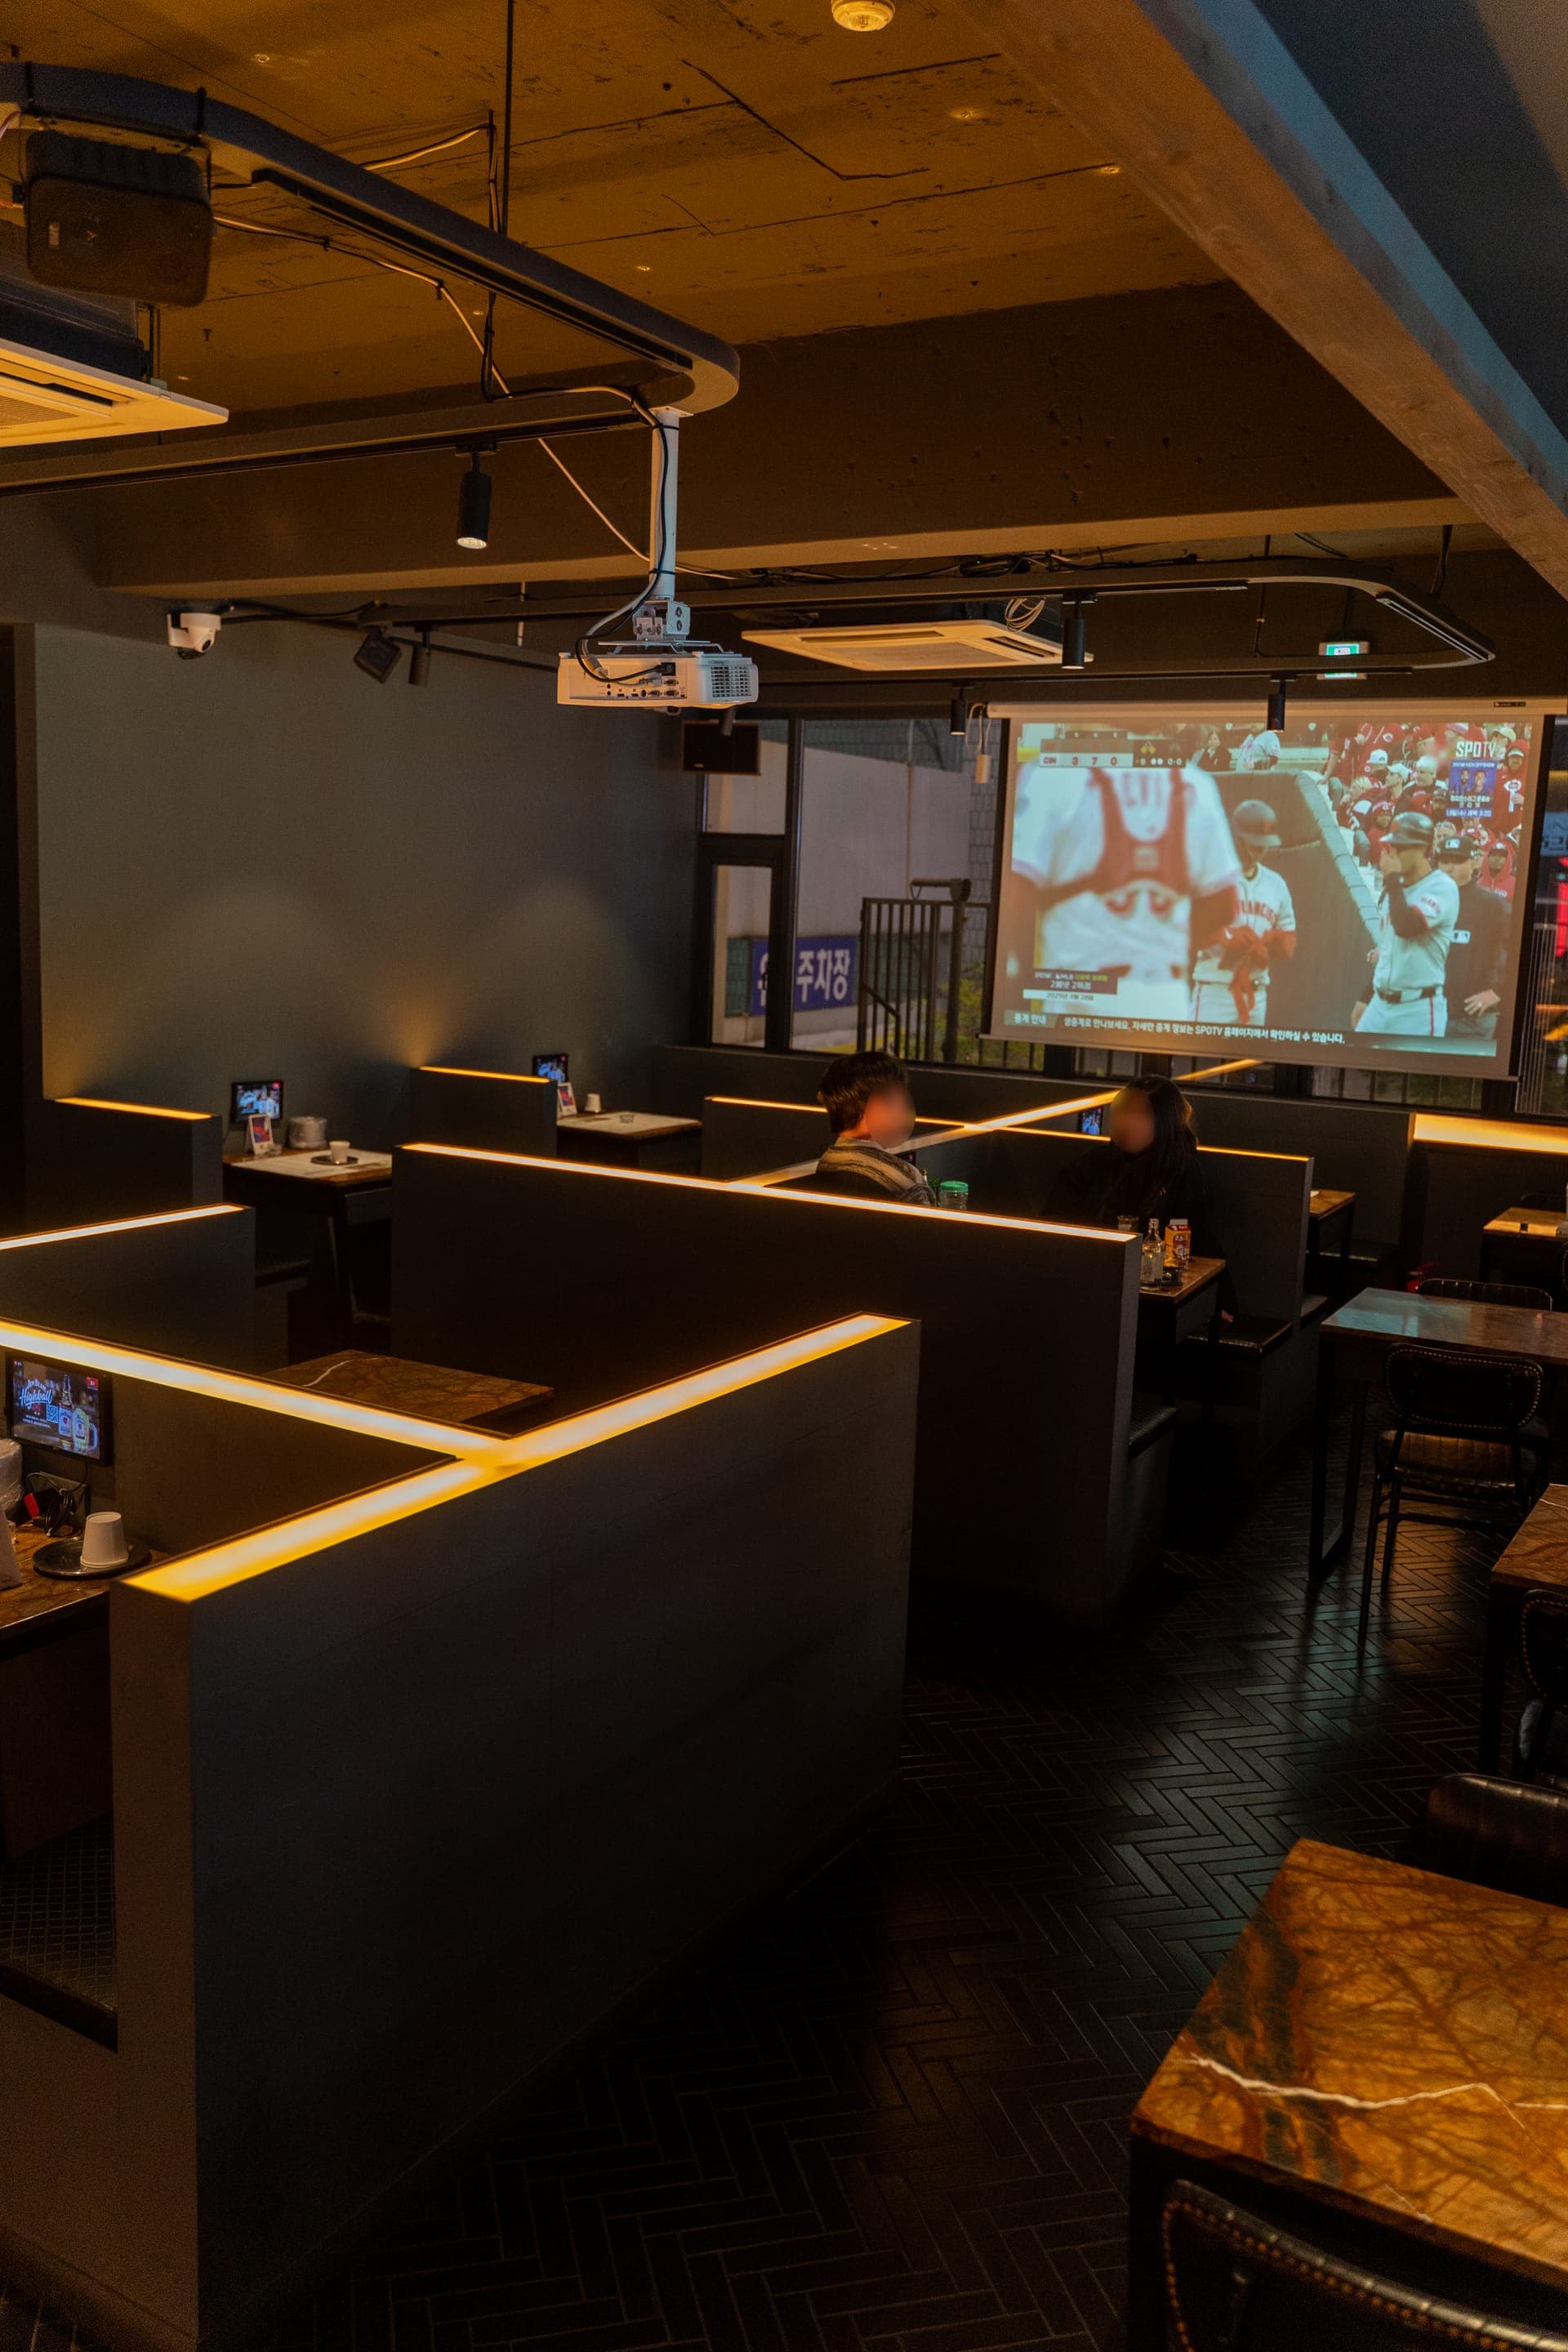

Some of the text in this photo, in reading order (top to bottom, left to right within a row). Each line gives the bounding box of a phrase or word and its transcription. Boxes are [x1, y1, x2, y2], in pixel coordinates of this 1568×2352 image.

[1455, 742, 1496, 758] SPOTV
[1071, 756, 1079, 765] 3
[1091, 756, 1098, 765] 7
[1110, 756, 1117, 765] 0
[1014, 1013, 1046, 1025] 중계 안내
[1132, 1021, 1154, 1031] 자세한
[1156, 1022, 1171, 1033] 중계
[1173, 1023, 1195, 1035] 정보는
[1195, 1024, 1223, 1036] SPOTV
[1224, 1026, 1268, 1039] 홈페이지에서
[1270, 1028, 1301, 1041] 확인하실
[1302, 1031, 1311, 1041] 수
[1312, 1031, 1346, 1045] 있습니다.
[20, 1388, 53, 1410] Highball
